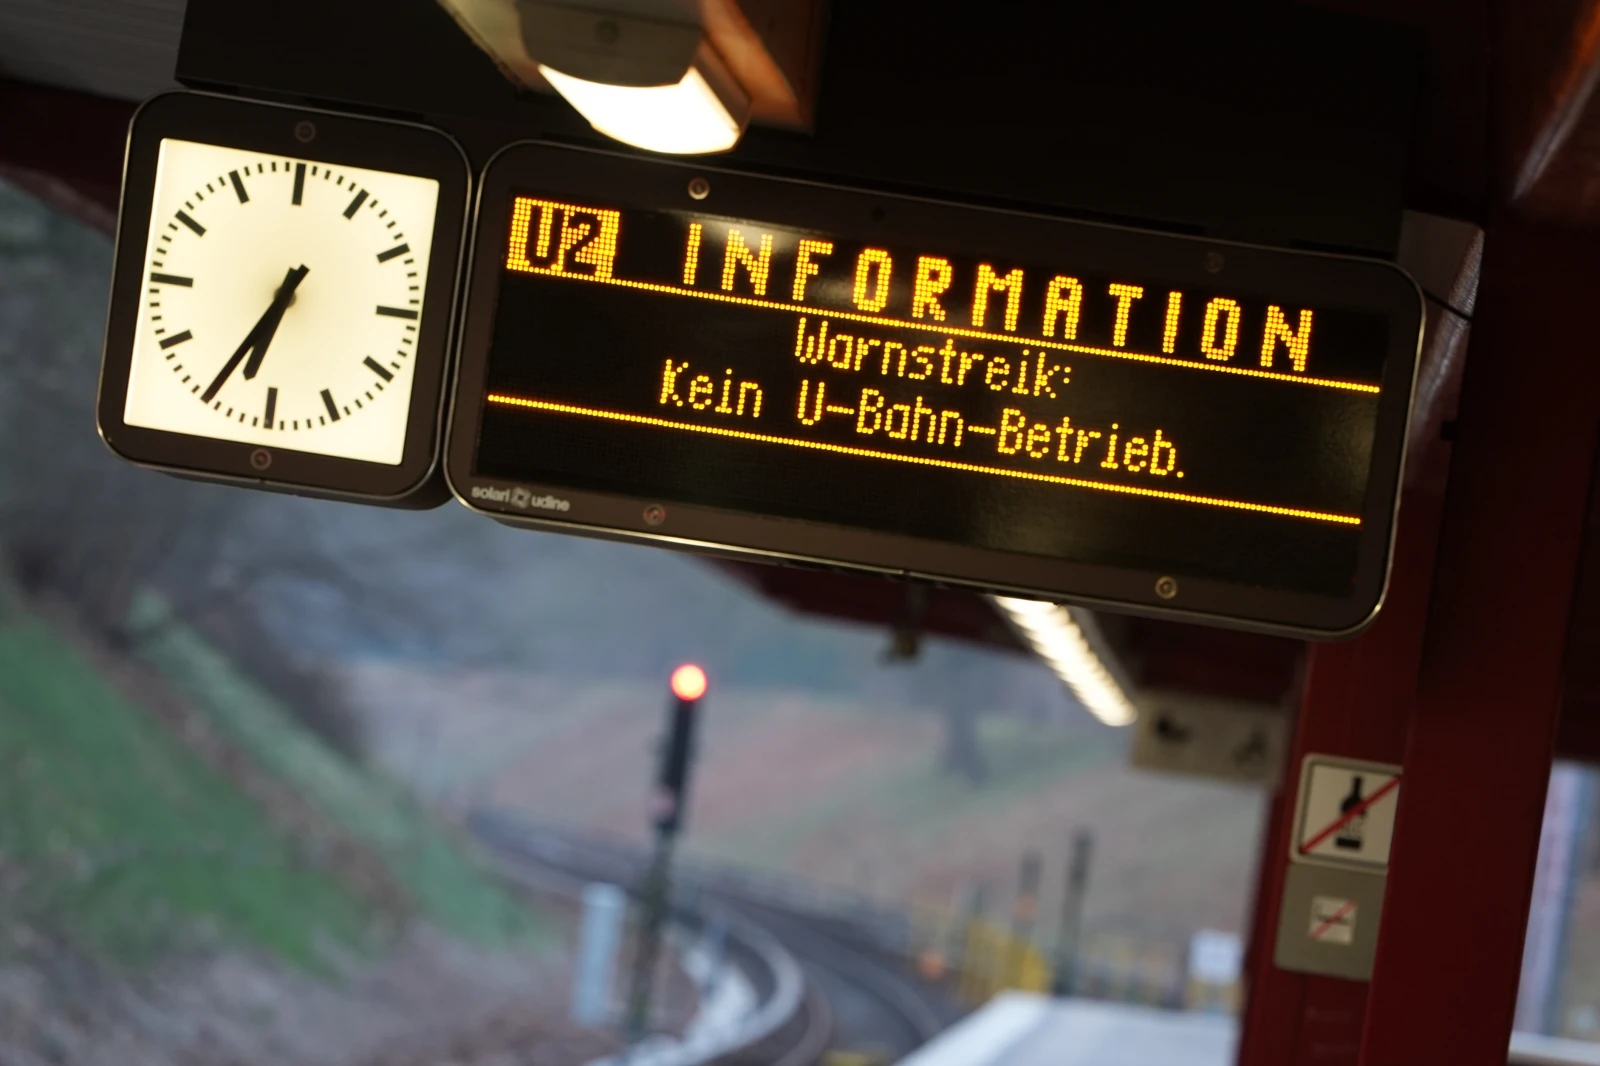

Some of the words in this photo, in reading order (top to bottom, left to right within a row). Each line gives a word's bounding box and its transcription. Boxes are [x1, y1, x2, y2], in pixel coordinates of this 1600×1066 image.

[520, 203, 608, 279] U2
[683, 223, 1313, 372] INFORMATION
[795, 317, 1072, 398] Warnstreik:
[660, 359, 763, 418] Kein
[797, 379, 1184, 479] U-Bahn-Betrieb.
[471, 486, 510, 501] solari
[531, 495, 570, 512] udine
